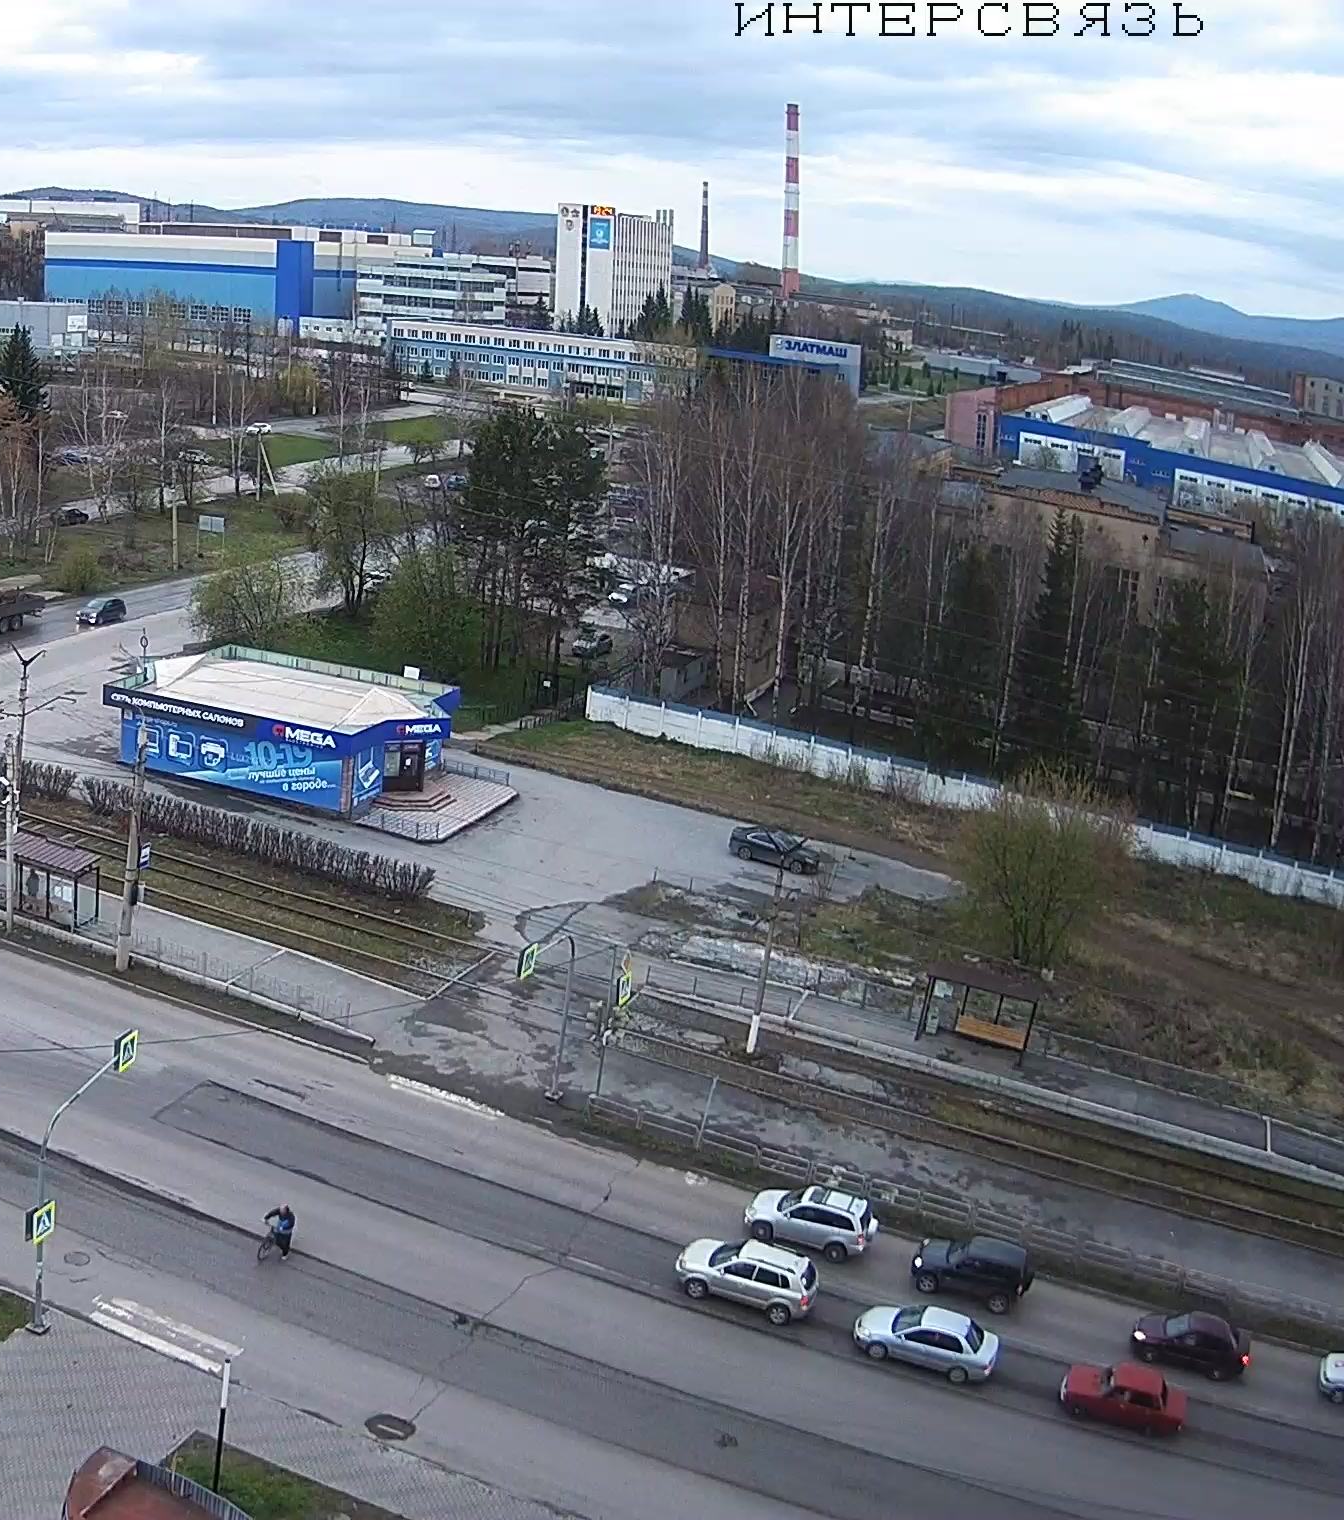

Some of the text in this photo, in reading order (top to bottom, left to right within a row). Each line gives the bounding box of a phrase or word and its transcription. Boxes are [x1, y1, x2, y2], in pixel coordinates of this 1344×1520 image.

[784, 340, 847, 358] ЗЛАТМАШ
[110, 693, 245, 728] СЕТЬ КОМПЬЮТЕРНЫХ САЛОНОВ
[247, 768, 287, 782] лучшие
[288, 766, 316, 778] цены
